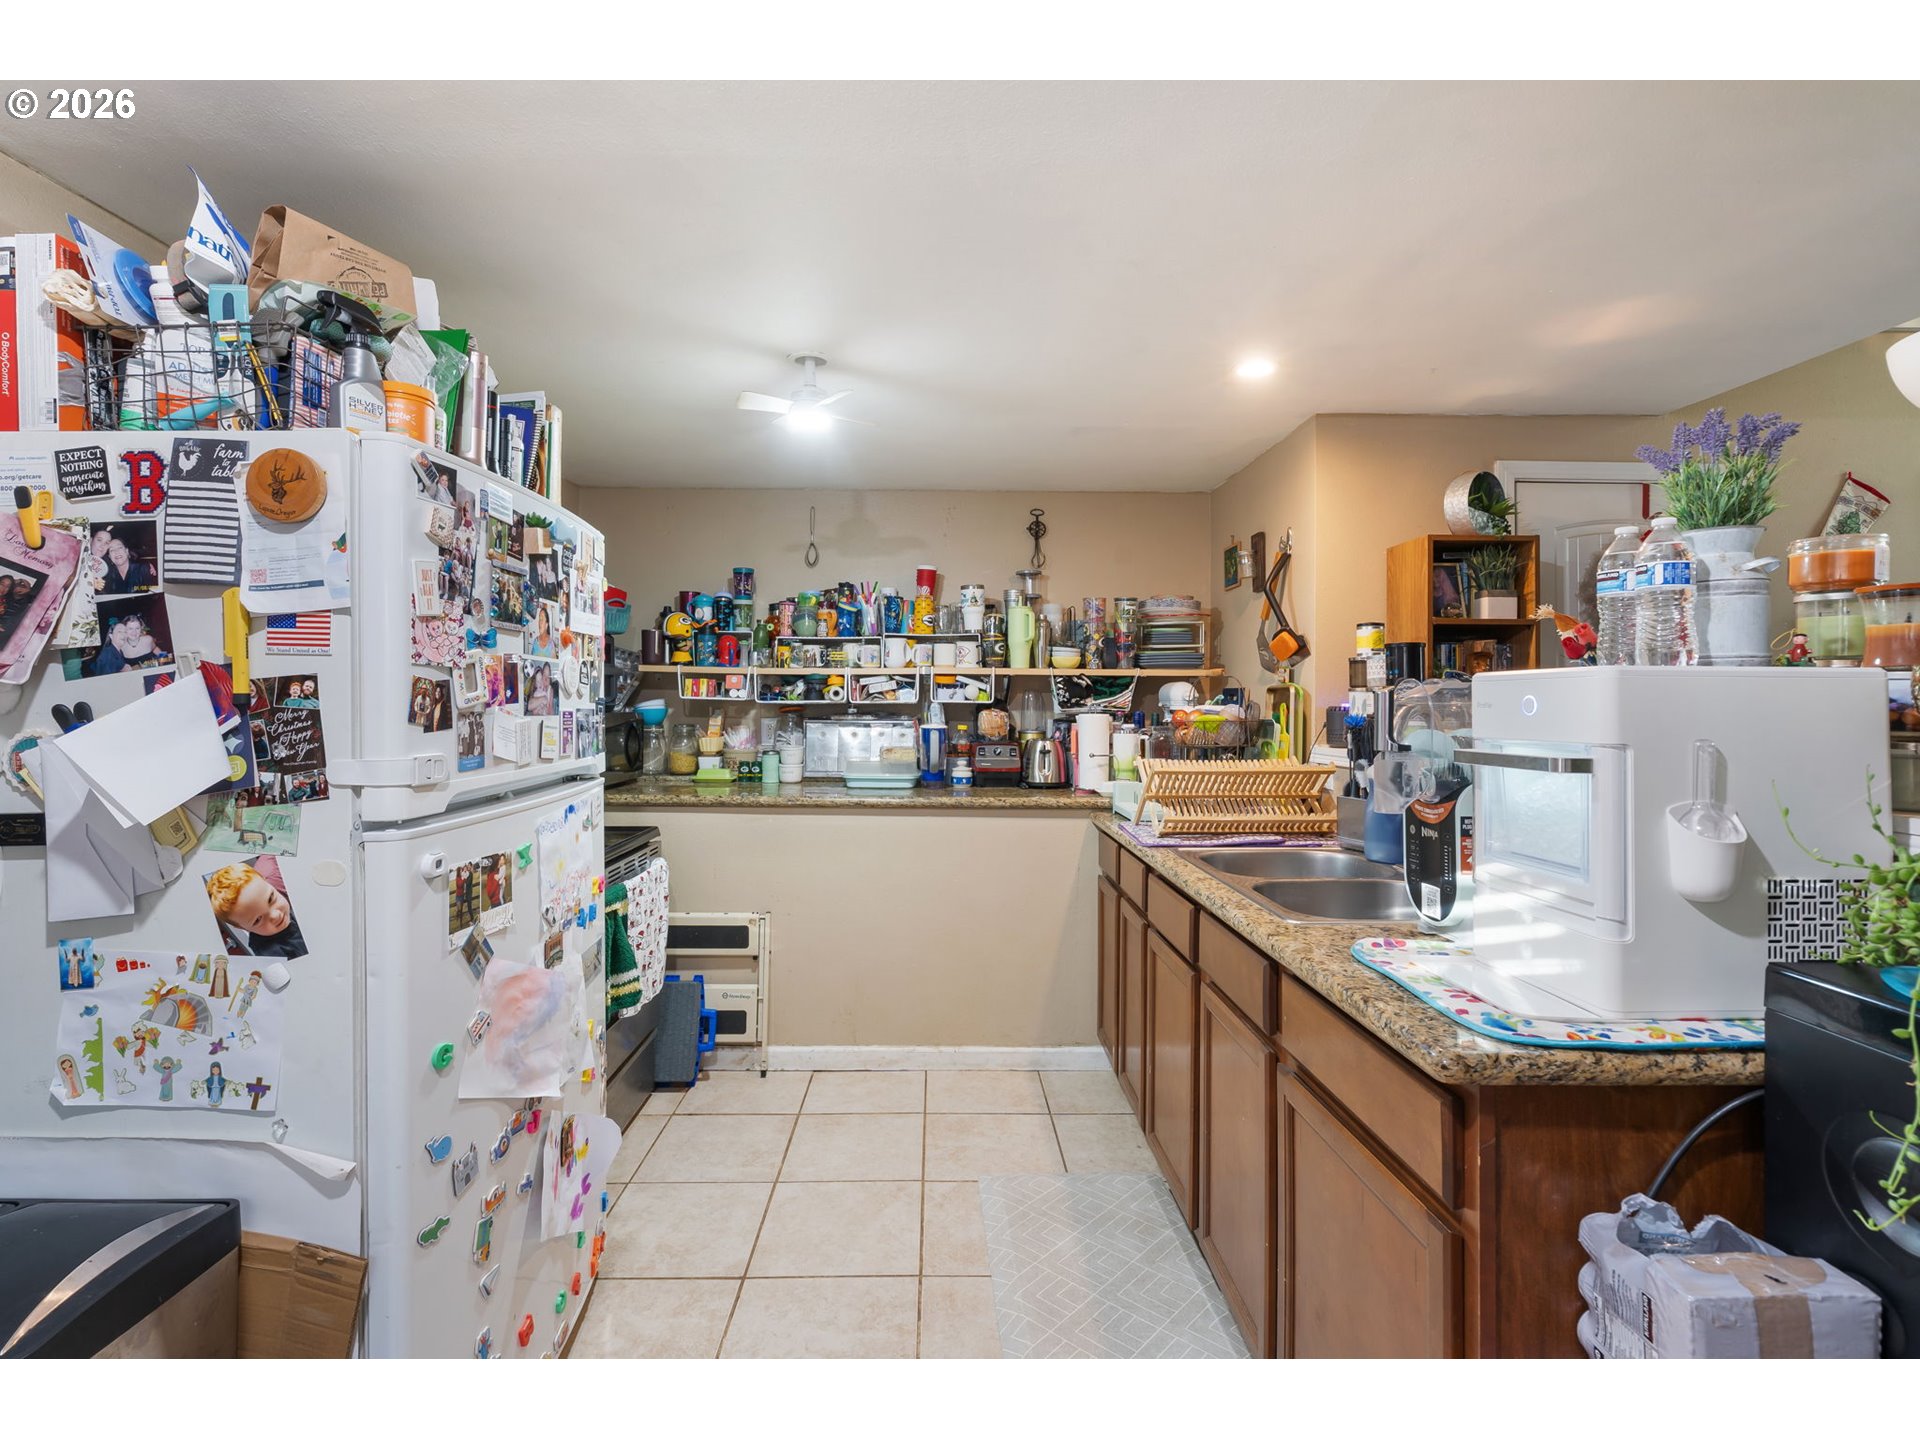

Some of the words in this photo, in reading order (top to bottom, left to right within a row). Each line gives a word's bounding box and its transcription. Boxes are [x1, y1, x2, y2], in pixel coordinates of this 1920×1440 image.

[1, 340, 9, 395] BodyComfort
[348, 396, 384, 411] SILVER
[59, 448, 103, 463] EXPECT
[213, 442, 245, 459] farm
[60, 459, 104, 473] NOTHING
[221, 458, 231, 467] to
[61, 471, 105, 485] appreciate
[211, 464, 236, 478] tabl
[62, 480, 107, 495] everything
[118, 447, 170, 518] B
[14, 544, 56, 570] Memory
[274, 708, 309, 724] Merry
[267, 720, 313, 737] Christmas
[280, 730, 314, 747] Happy
[295, 741, 320, 762] Year
[1420, 825, 1439, 841] NINJA
[1642, 1294, 1650, 1338] KIRKLAND
